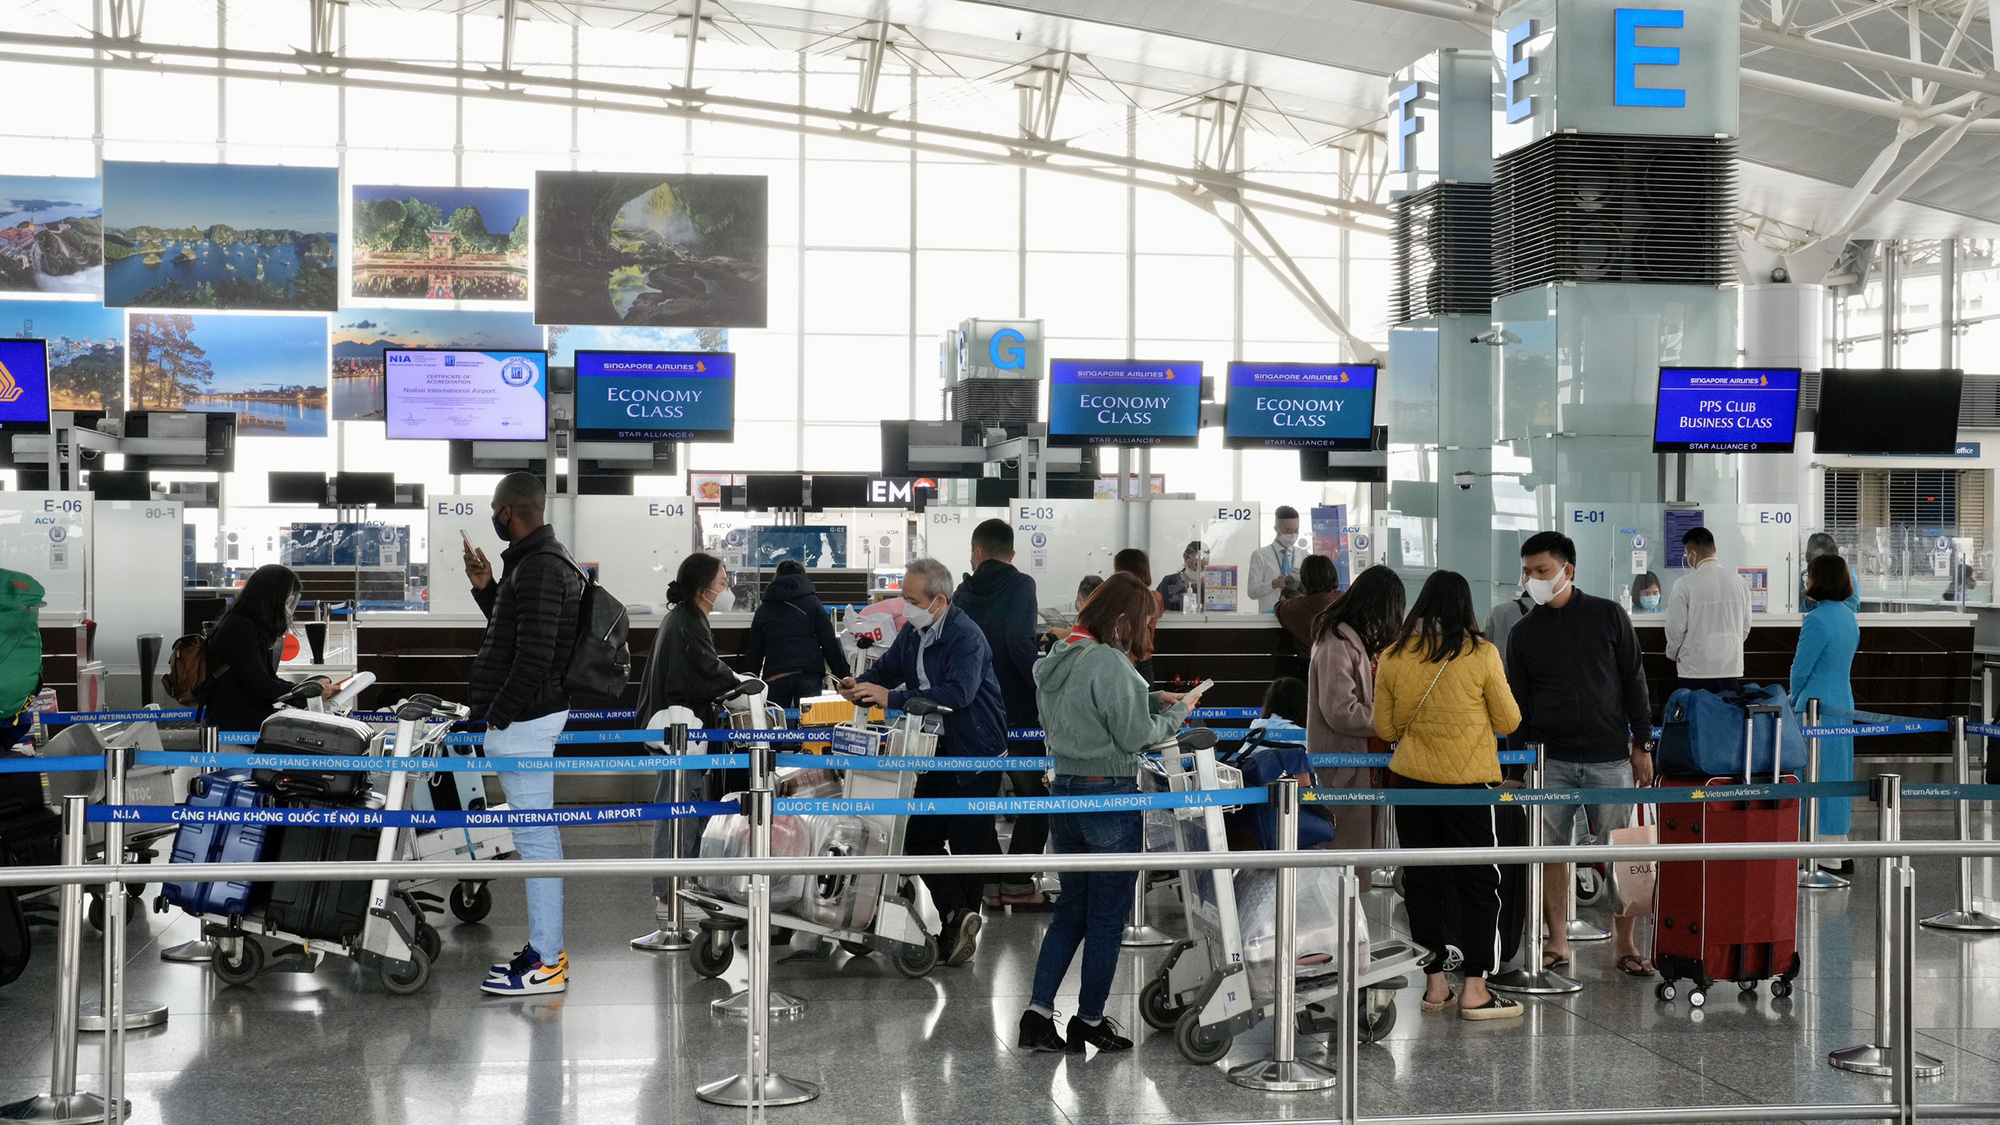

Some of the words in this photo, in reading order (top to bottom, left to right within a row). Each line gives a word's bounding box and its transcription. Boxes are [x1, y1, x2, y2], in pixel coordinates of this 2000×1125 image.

[1613, 8, 1686, 108] E
[1506, 18, 1533, 125] E
[1400, 81, 1418, 173] F
[989, 328, 1026, 371] G
[389, 355, 412, 363] NIA
[603, 362, 653, 370] SINGAPORE
[607, 387, 703, 403] ECONOMY
[1080, 394, 1170, 409] ECONOMY
[626, 403, 684, 418] CLASS
[1256, 397, 1345, 412] ECONOMY
[1699, 400, 1722, 413] PPS
[1725, 400, 1757, 413] CLUB
[1097, 410, 1152, 424] CLASS
[1273, 412, 1326, 427] CLASS
[1679, 416, 1734, 428] BUSINESS
[1737, 416, 1773, 429] CLASS
[1956, 447, 1974, 455] office
[44, 499, 83, 513] E-06
[438, 502, 474, 516] E-05
[649, 503, 685, 517] E-04
[1019, 506, 1054, 520] E-03
[1218, 508, 1252, 521] E-02
[1573, 510, 1605, 523] E-01
[1760, 511, 1793, 524] E-00
[34, 517, 56, 525] ACV
[1018, 524, 1038, 532] ACV
[1342, 526, 1361, 534] ACV
[1620, 527, 1638, 535] ACV
[98, 712, 159, 720] INTERNATIONAL
[160, 711, 193, 719] AIRPORT
[599, 732, 621, 740] N.I.A
[688, 731, 708, 739] N.I.A
[777, 730, 805, 740] KHÔNG
[1022, 730, 1046, 738] AIRPO
[1806, 727, 1860, 736] INTERNATIONAL
[1860, 725, 1890, 734] AIRPORT
[1905, 723, 1922, 731] N.I.A
[190, 755, 217, 764] N.I.A
[467, 759, 493, 769] N.I.A
[517, 760, 553, 770] NOIBAI
[555, 758, 637, 769] INTERNATIONAL
[637, 757, 682, 767] AIRPORT
[711, 757, 737, 766] N.I.A
[825, 758, 851, 767] N.I.A
[1901, 788, 1926, 796] ietnam
[907, 802, 936, 812] N.I.A
[968, 801, 1007, 811] NOIBAI
[1010, 799, 1102, 811] INTERNATIONAL
[1102, 796, 1154, 808] AIRPORT
[1185, 793, 1213, 804] N.I.A
[113, 811, 141, 819] N.I.A
[243, 810, 284, 823] KHÔNG
[288, 810, 320, 824] QUỐC
[323, 810, 338, 824] TẾ
[339, 812, 360, 826] NỘI
[410, 813, 437, 824] N.I.A
[465, 813, 503, 824] NOIBAI
[507, 810, 593, 824] INTERNATIONAL
[597, 808, 643, 820] AIRPORT
[670, 804, 697, 816] N.I.A
[1630, 864, 1657, 875] EXUL
[375, 897, 384, 907] T2
[1231, 952, 1241, 962] T2
[1227, 991, 1237, 1002] T2
